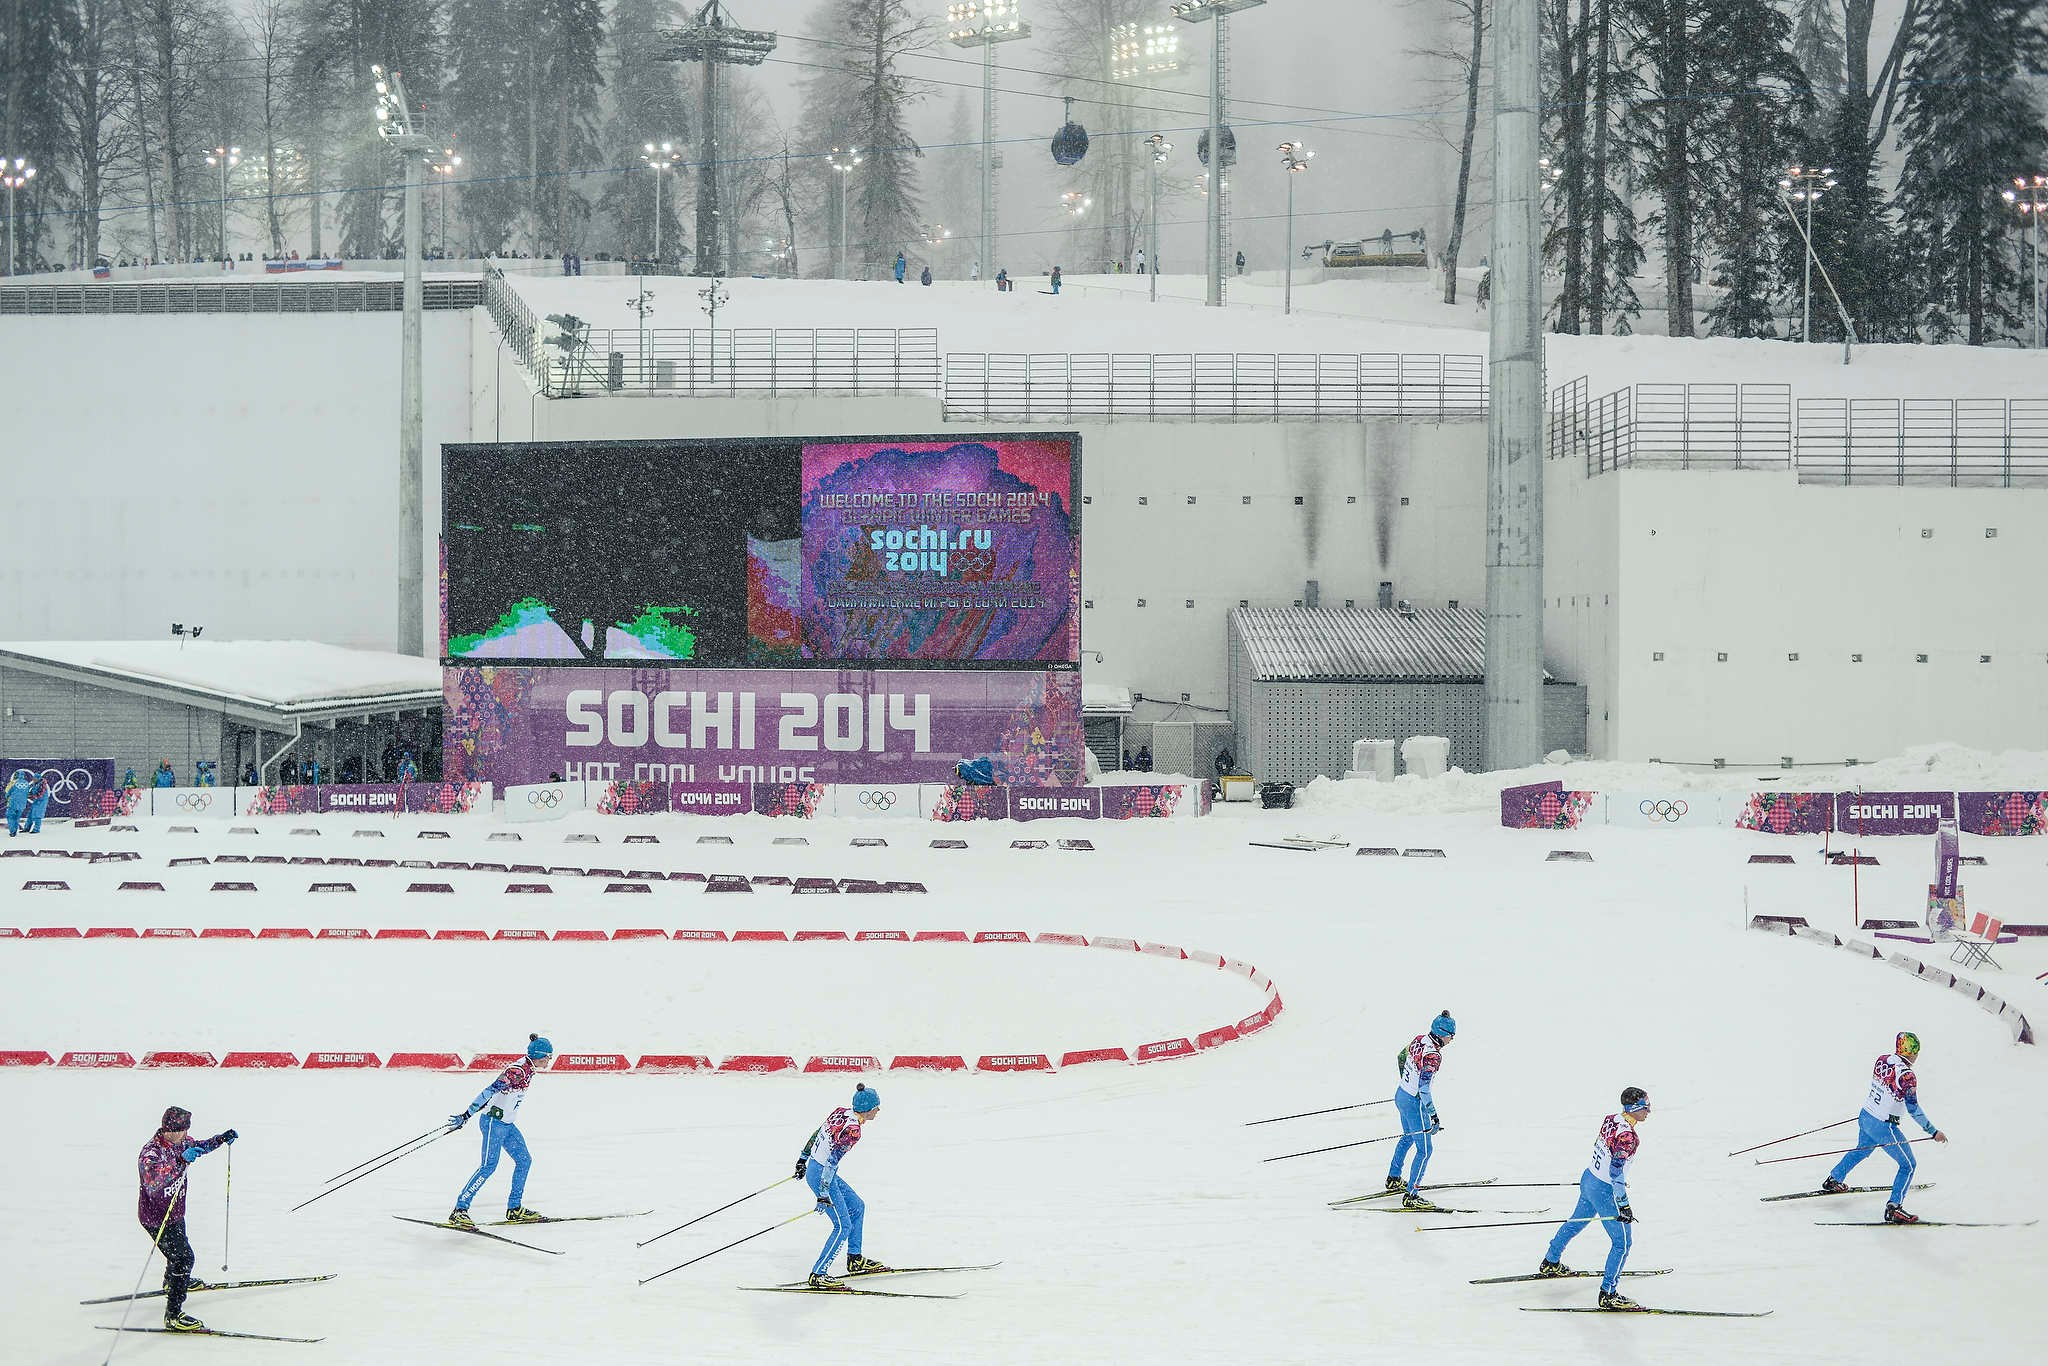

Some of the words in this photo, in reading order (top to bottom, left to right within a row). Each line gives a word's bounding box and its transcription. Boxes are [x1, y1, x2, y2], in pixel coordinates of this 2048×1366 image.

[820, 494, 894, 509] WELCOME
[899, 494, 918, 508] TO
[923, 494, 951, 508] THE
[956, 493, 1001, 508] SOCHI
[1006, 492, 1050, 507] 2014
[871, 525, 991, 550] sochi.ru
[565, 690, 756, 750] SOCHI
[779, 692, 931, 752] 2014
[331, 793, 366, 806] SOCHI
[369, 793, 397, 806] 2014
[680, 792, 712, 805] СОЧИ
[714, 792, 741, 805] 2014
[1018, 798, 1056, 811] SOCHI
[1060, 798, 1091, 811] 2014
[1848, 804, 1899, 819] SOCHI
[1903, 804, 1942, 819] 2014
[328, 929, 346, 937] SOCHI
[347, 929, 361, 937] 2014
[503, 930, 521, 938] SOCHI
[522, 930, 537, 938] 2014
[1147, 1044, 1167, 1055] SOCHI
[1167, 1040, 1183, 1051] 2014
[72, 1053, 97, 1062] SOCHI
[98, 1053, 118, 1062] 2014
[318, 1053, 342, 1063] SOCHI
[344, 1053, 365, 1063] 2014
[569, 1055, 594, 1065] SOCHI
[596, 1055, 617, 1065] 2014
[822, 1056, 848, 1066] SOCHI
[849, 1057, 869, 1067] 2014
[991, 1057, 1016, 1066] SOCHI
[1018, 1056, 1038, 1065] 2014
